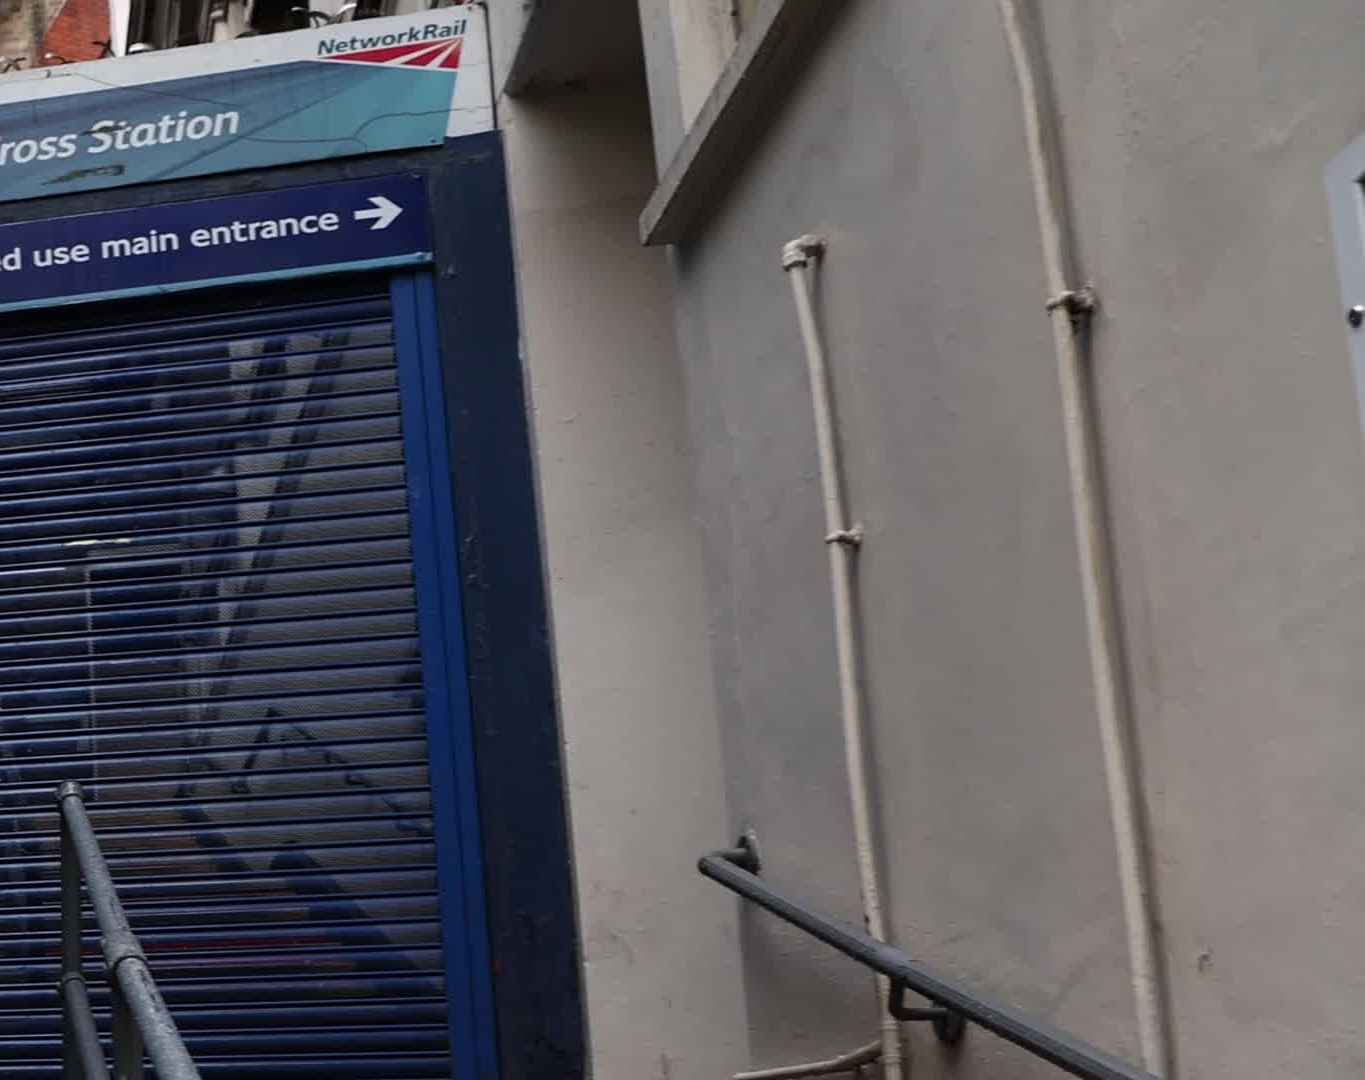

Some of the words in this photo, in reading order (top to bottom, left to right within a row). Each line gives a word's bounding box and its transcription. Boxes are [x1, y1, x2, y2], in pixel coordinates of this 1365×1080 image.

[318, 20, 467, 56] NetworkRail
[87, 110, 239, 155] Station
[33, 242, 90, 266] use
[101, 229, 179, 259] main
[190, 210, 340, 249] entrance
